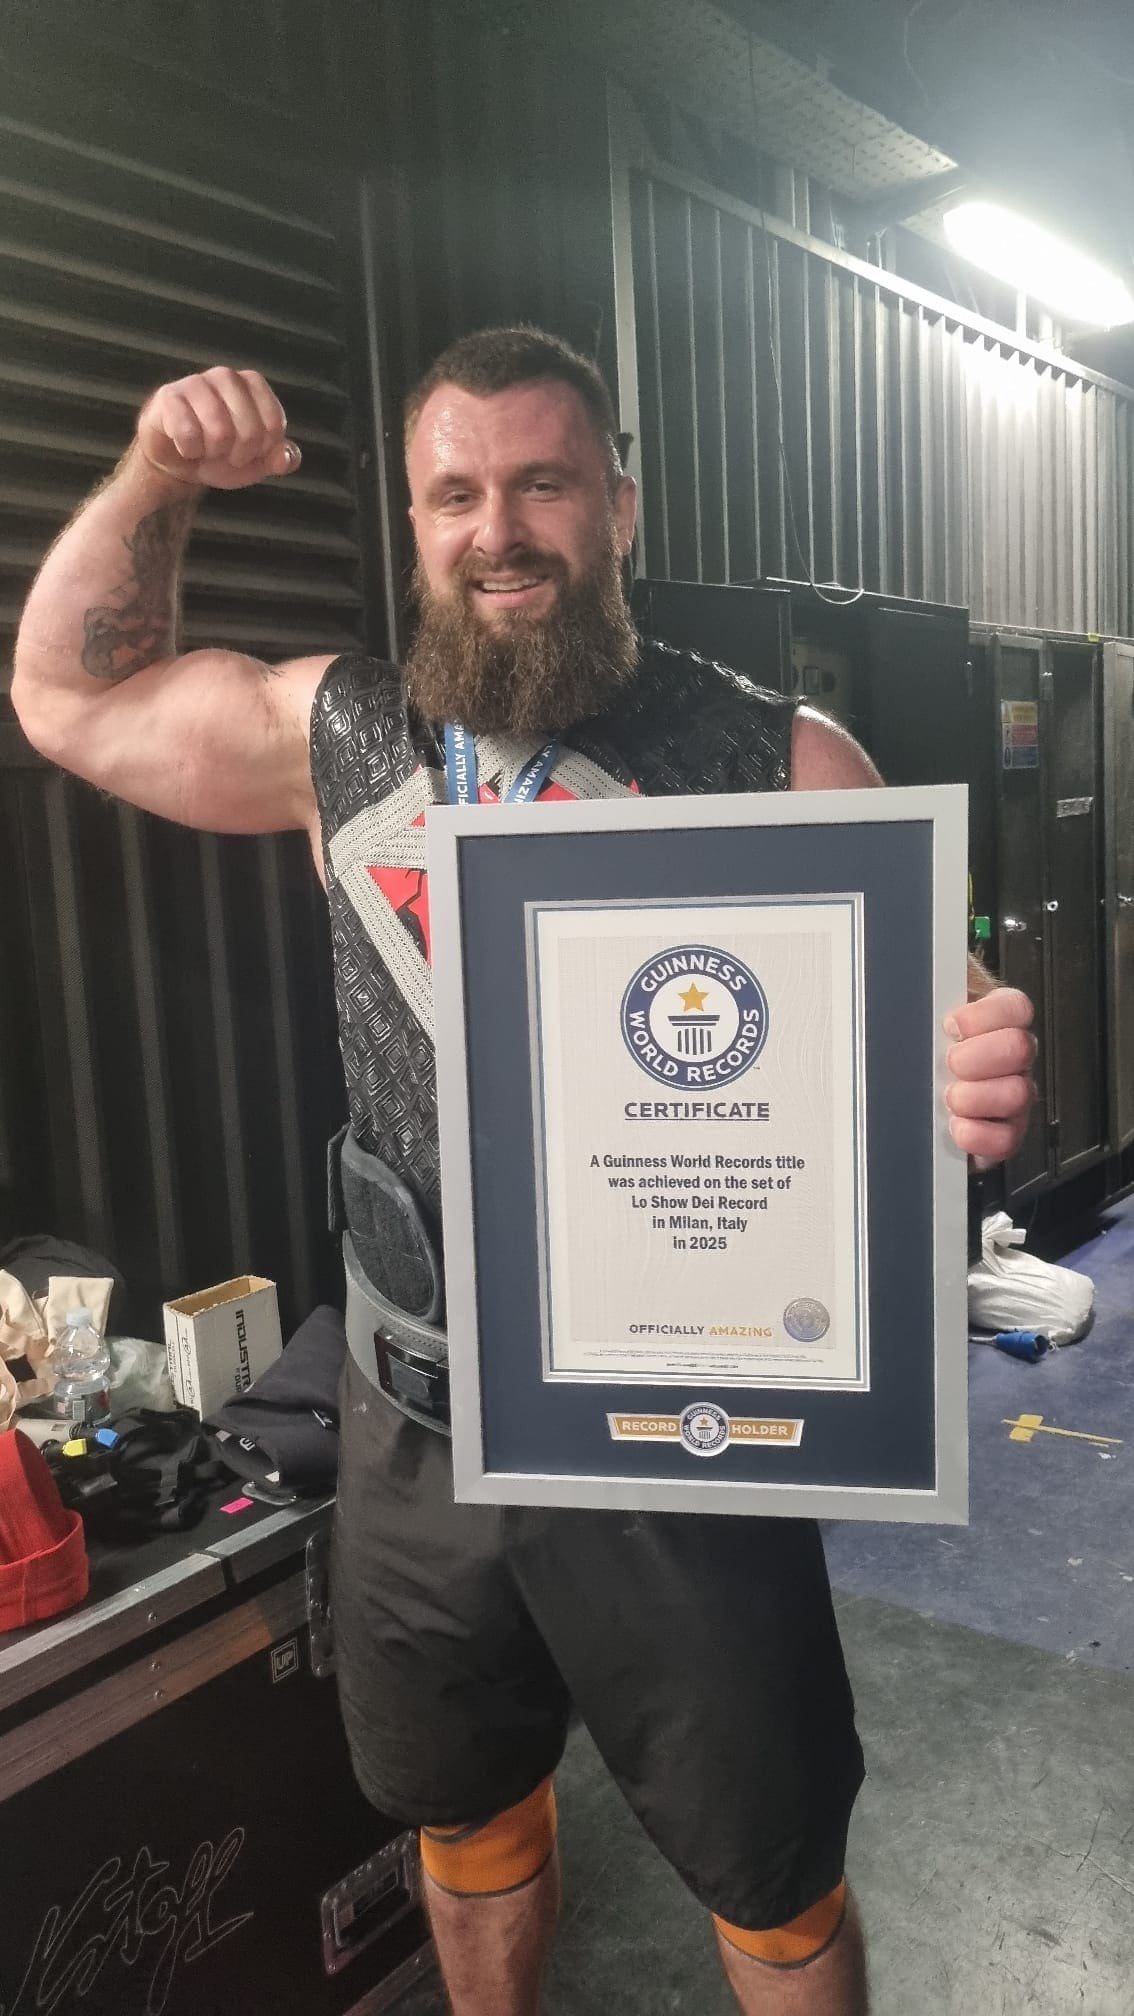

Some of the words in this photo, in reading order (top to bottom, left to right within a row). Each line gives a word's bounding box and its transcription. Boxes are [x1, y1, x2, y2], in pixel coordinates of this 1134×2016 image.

[455, 753, 469, 805] FICIALLY
[641, 954, 747, 993] GUINNESS
[629, 1010, 677, 1078] WORLD
[686, 1008, 760, 1082] RECORDS
[624, 1101, 770, 1120] CERTIFICATE
[590, 1155, 600, 1168] A
[603, 1155, 667, 1168] Guinness
[670, 1155, 711, 1168] World
[715, 1155, 772, 1169] Records
[775, 1155, 805, 1170] title
[608, 1177, 635, 1188] was
[638, 1175, 700, 1189] achieved
[703, 1179, 721, 1189] on
[725, 1176, 747, 1189] the
[751, 1177, 773, 1190] set
[777, 1176, 791, 1190] of
[631, 1196, 647, 1209] Lo
[651, 1196, 688, 1209] Show
[692, 1196, 714, 1209] Dei
[718, 1196, 768, 1210] Record
[652, 1216, 665, 1229] in
[669, 1216, 713, 1231] Milan,
[717, 1217, 748, 1232] Italy
[673, 1236, 686, 1249] in
[689, 1237, 727, 1250] 2025
[629, 1324, 704, 1336] OFFICIALLY
[709, 1326, 772, 1337] AMAZING
[235, 1309, 251, 1387] INDUSTR
[622, 1420, 677, 1432] RECORD
[732, 1423, 788, 1436] HOLDER
[683, 1424, 701, 1447] WORLD
[701, 1425, 726, 1448] RECORDS
